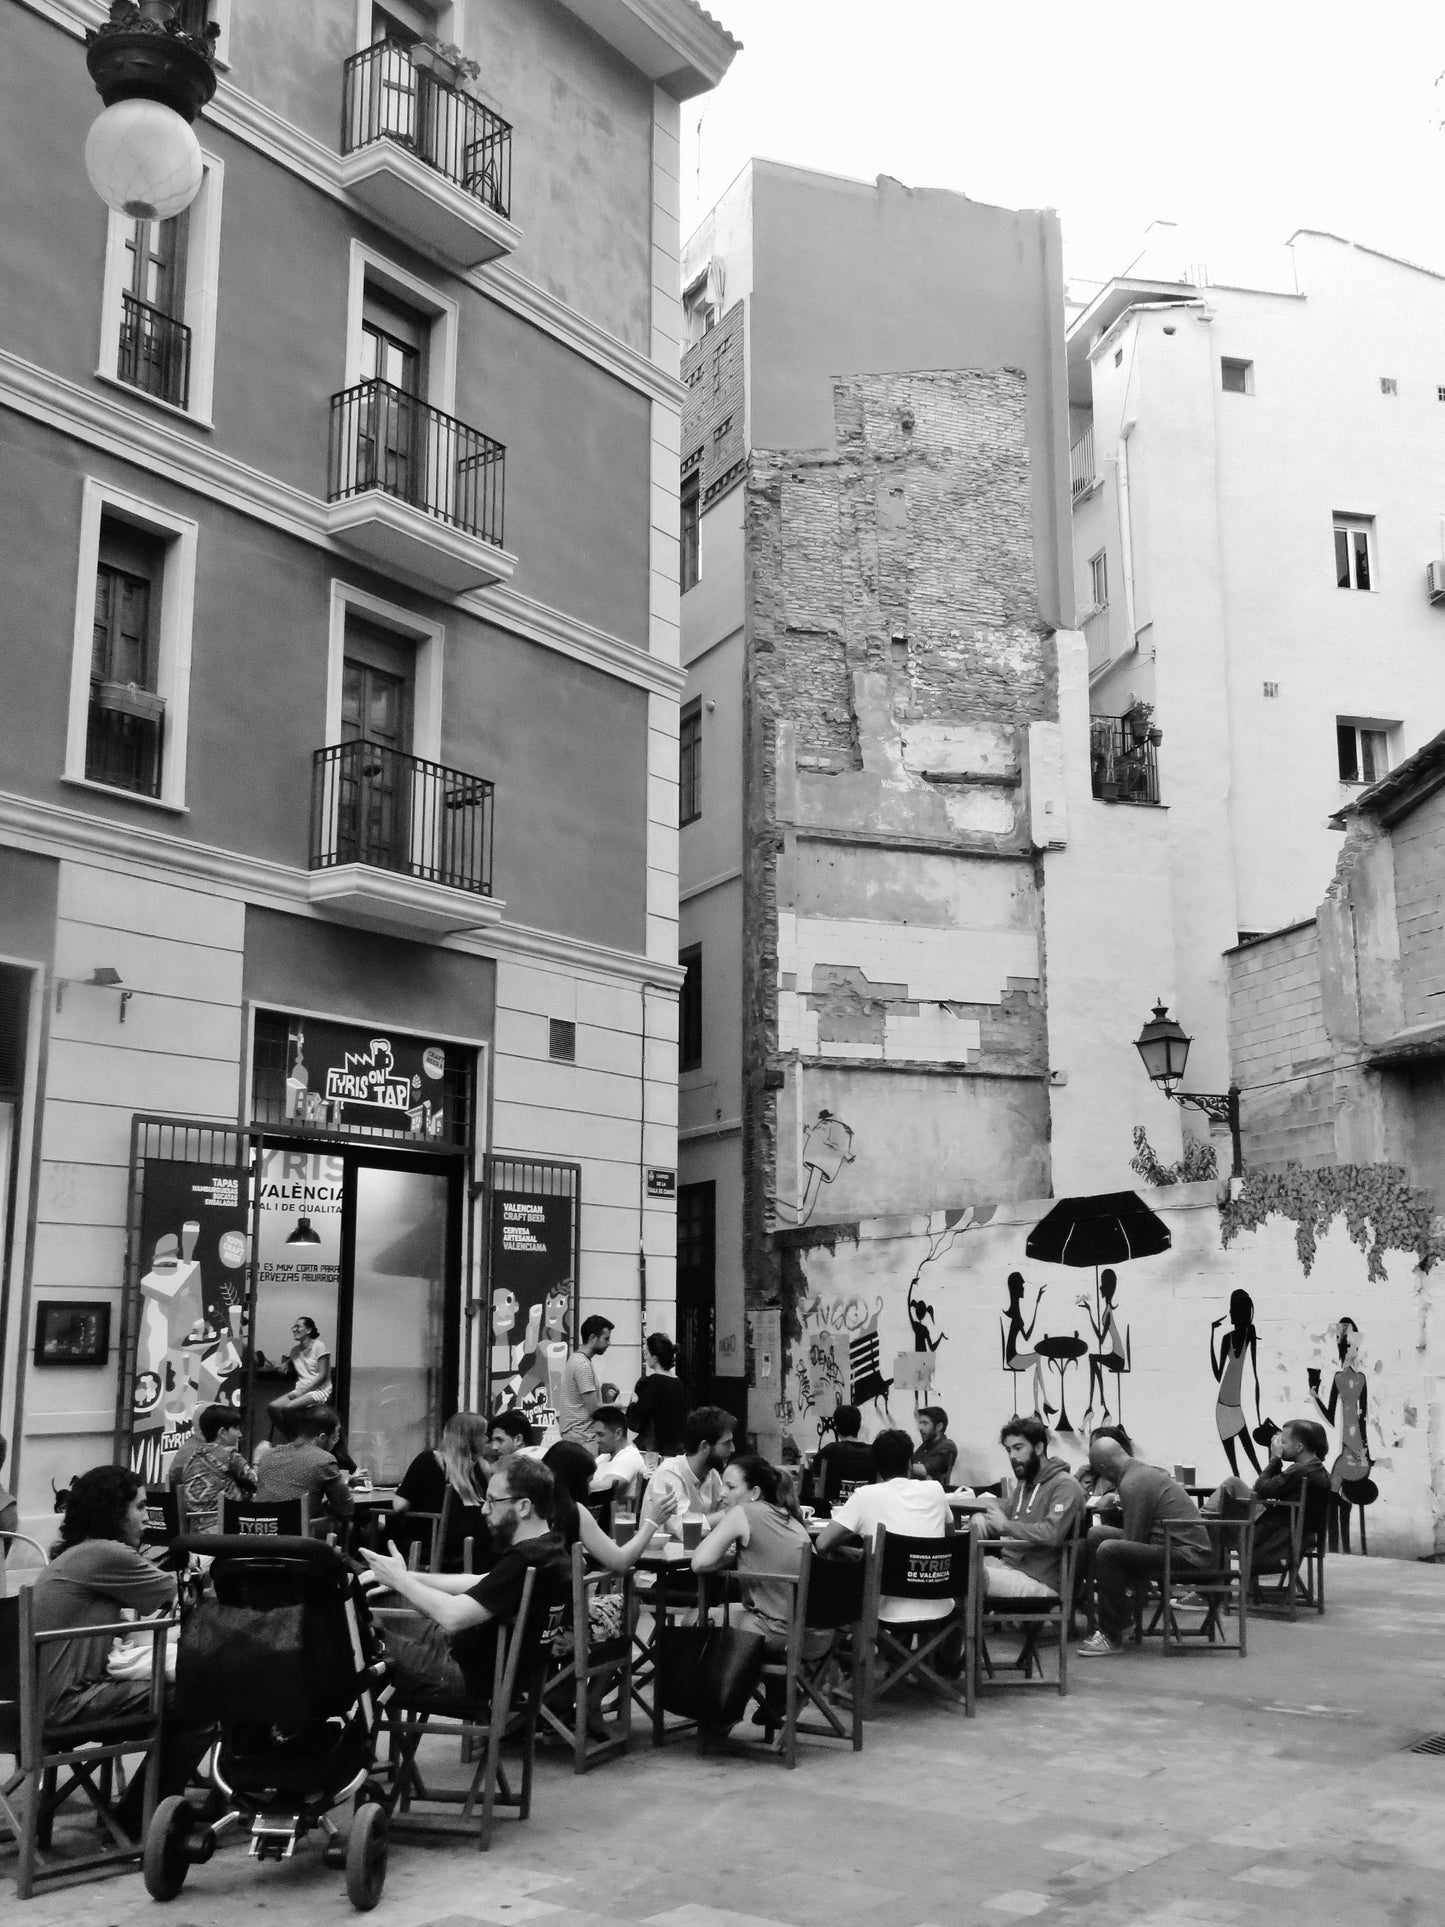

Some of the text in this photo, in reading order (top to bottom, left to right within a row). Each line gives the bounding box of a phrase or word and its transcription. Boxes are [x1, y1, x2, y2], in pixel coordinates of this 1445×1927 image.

[369, 1069, 385, 1084] ON
[330, 1073, 407, 1107] TYRIS TAP
[261, 1149, 344, 1182] YRIS
[212, 1178, 239, 1188] TAPAS
[261, 1181, 344, 1200] VALÈNCIA
[281, 1203, 295, 1211] DE
[298, 1204, 342, 1214] QUALITA
[503, 1203, 543, 1214] VALENCIAN
[503, 1212, 546, 1223] CRAFT BEER
[503, 1234, 538, 1243] ARTESANAL
[503, 1242, 547, 1252] VALENCIANA
[263, 1262, 340, 1273] ES MUY CORTA PARA
[302, 1273, 340, 1283] ABURRIDA
[534, 1404, 543, 1414] ON
[536, 1412, 555, 1426] TAP
[162, 1432, 185, 1450] TYRI
[238, 1522, 279, 1533] TYRIS
[909, 1559, 951, 1571] TYRIS
